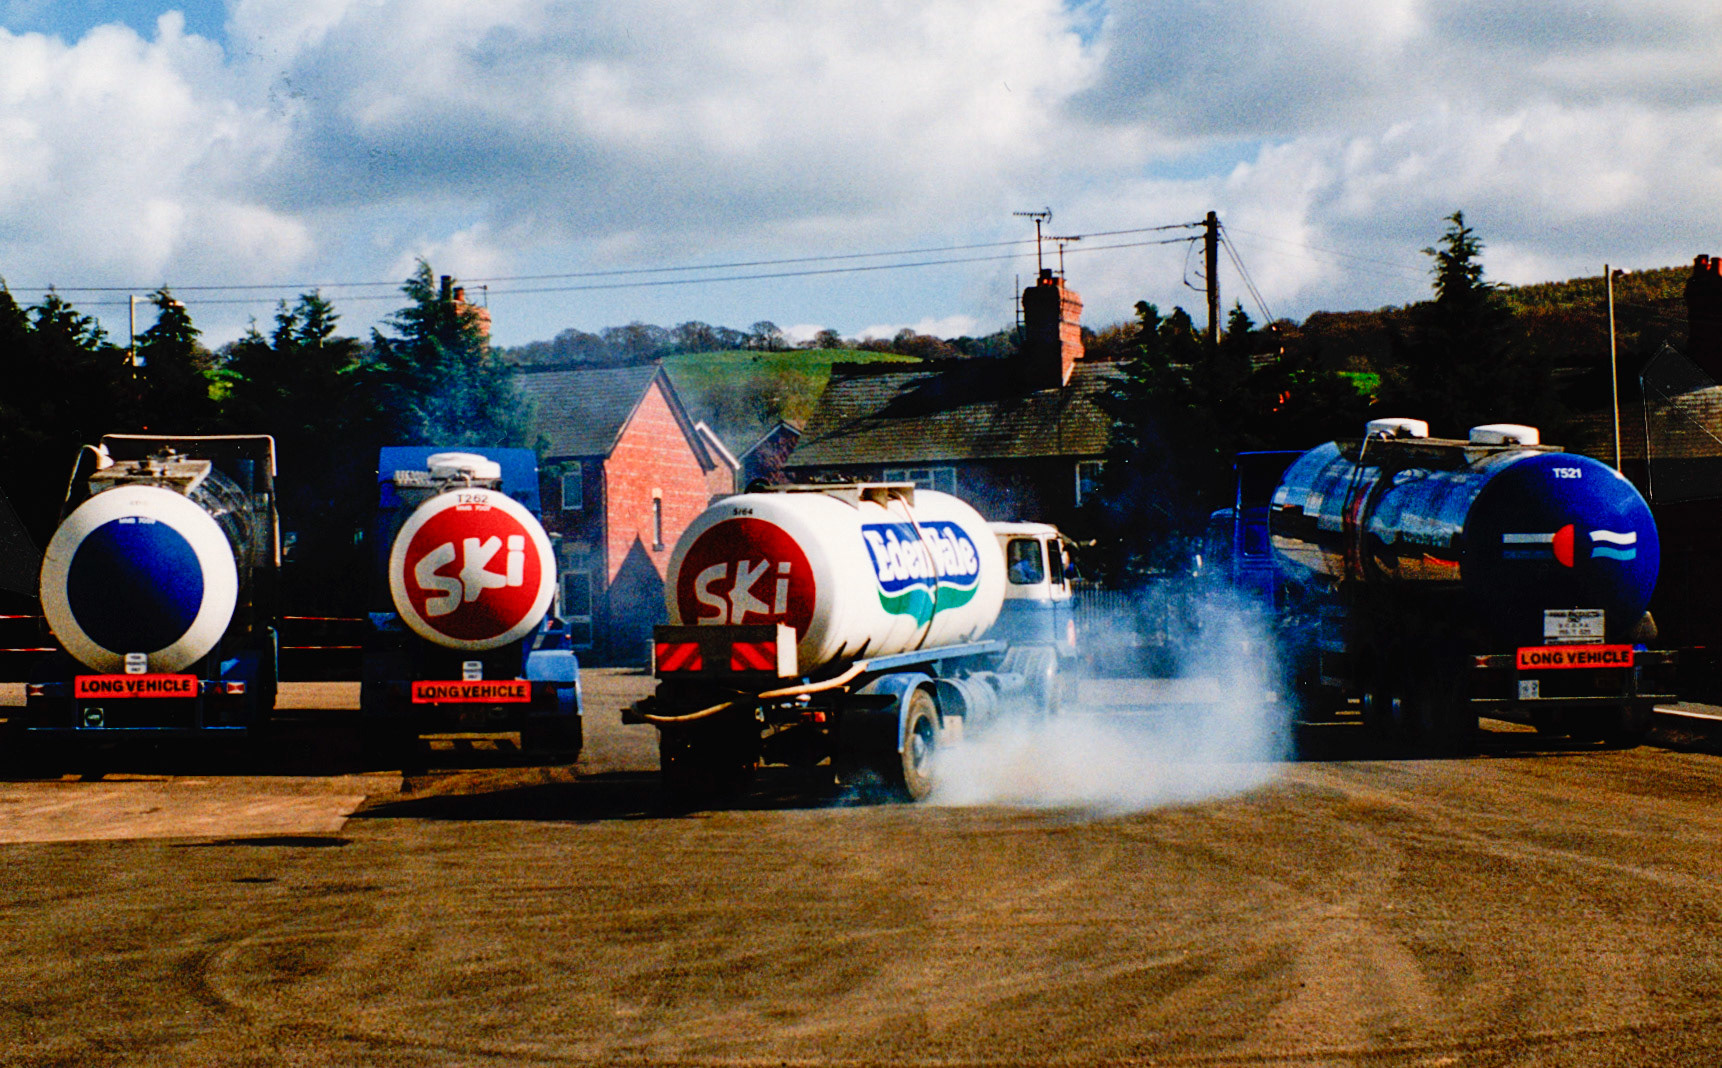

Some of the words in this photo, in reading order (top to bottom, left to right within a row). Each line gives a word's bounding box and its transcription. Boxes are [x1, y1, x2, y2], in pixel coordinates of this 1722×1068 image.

[1552, 467, 1582, 479] T521
[457, 494, 488, 503] T262
[1521, 653, 1563, 665] LONG
[1567, 651, 1630, 664] VEHICLE
[81, 680, 123, 692] LONG
[127, 679, 191, 692] VEHICLE
[417, 687, 459, 699] LONG
[462, 685, 526, 698] VEHICLE
